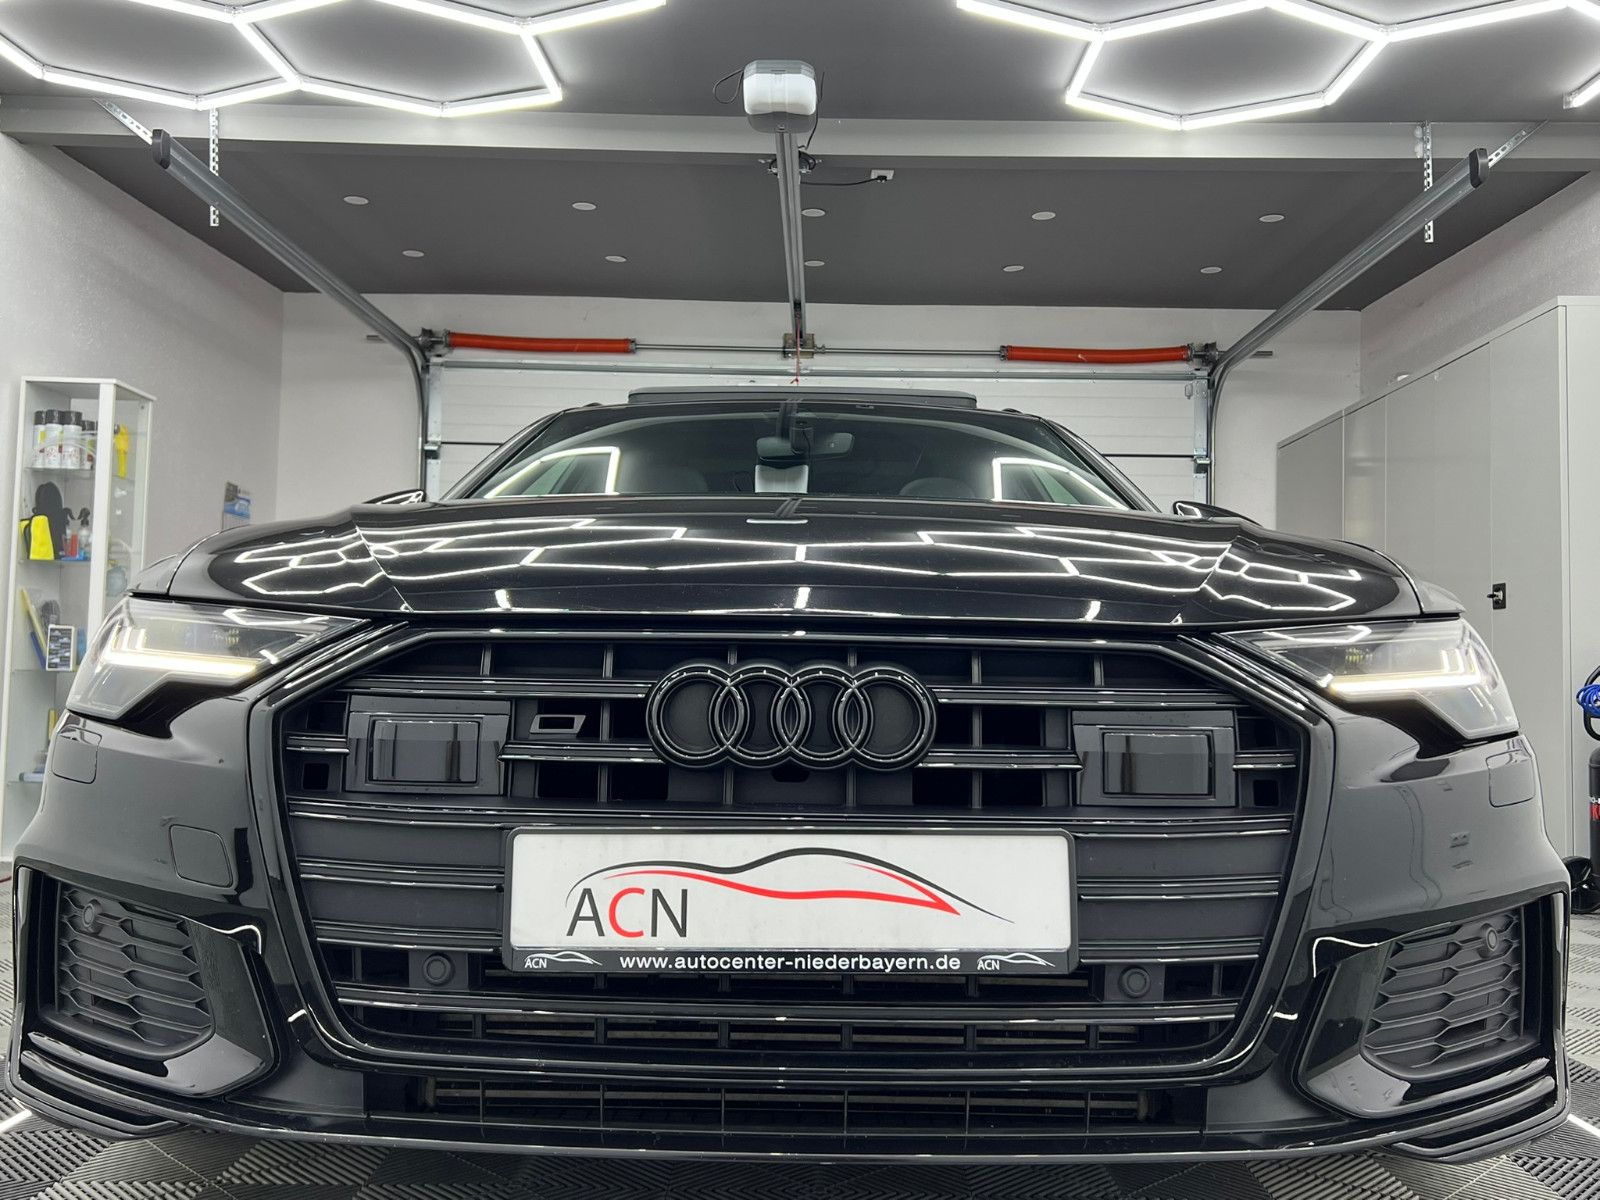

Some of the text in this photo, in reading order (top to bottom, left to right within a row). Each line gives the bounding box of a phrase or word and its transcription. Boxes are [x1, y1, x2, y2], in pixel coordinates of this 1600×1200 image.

[566, 887, 688, 938] ACN
[524, 957, 547, 969] ACN
[619, 955, 961, 973] www.autocenter-niederbayern.de
[976, 959, 1001, 971] ACN
